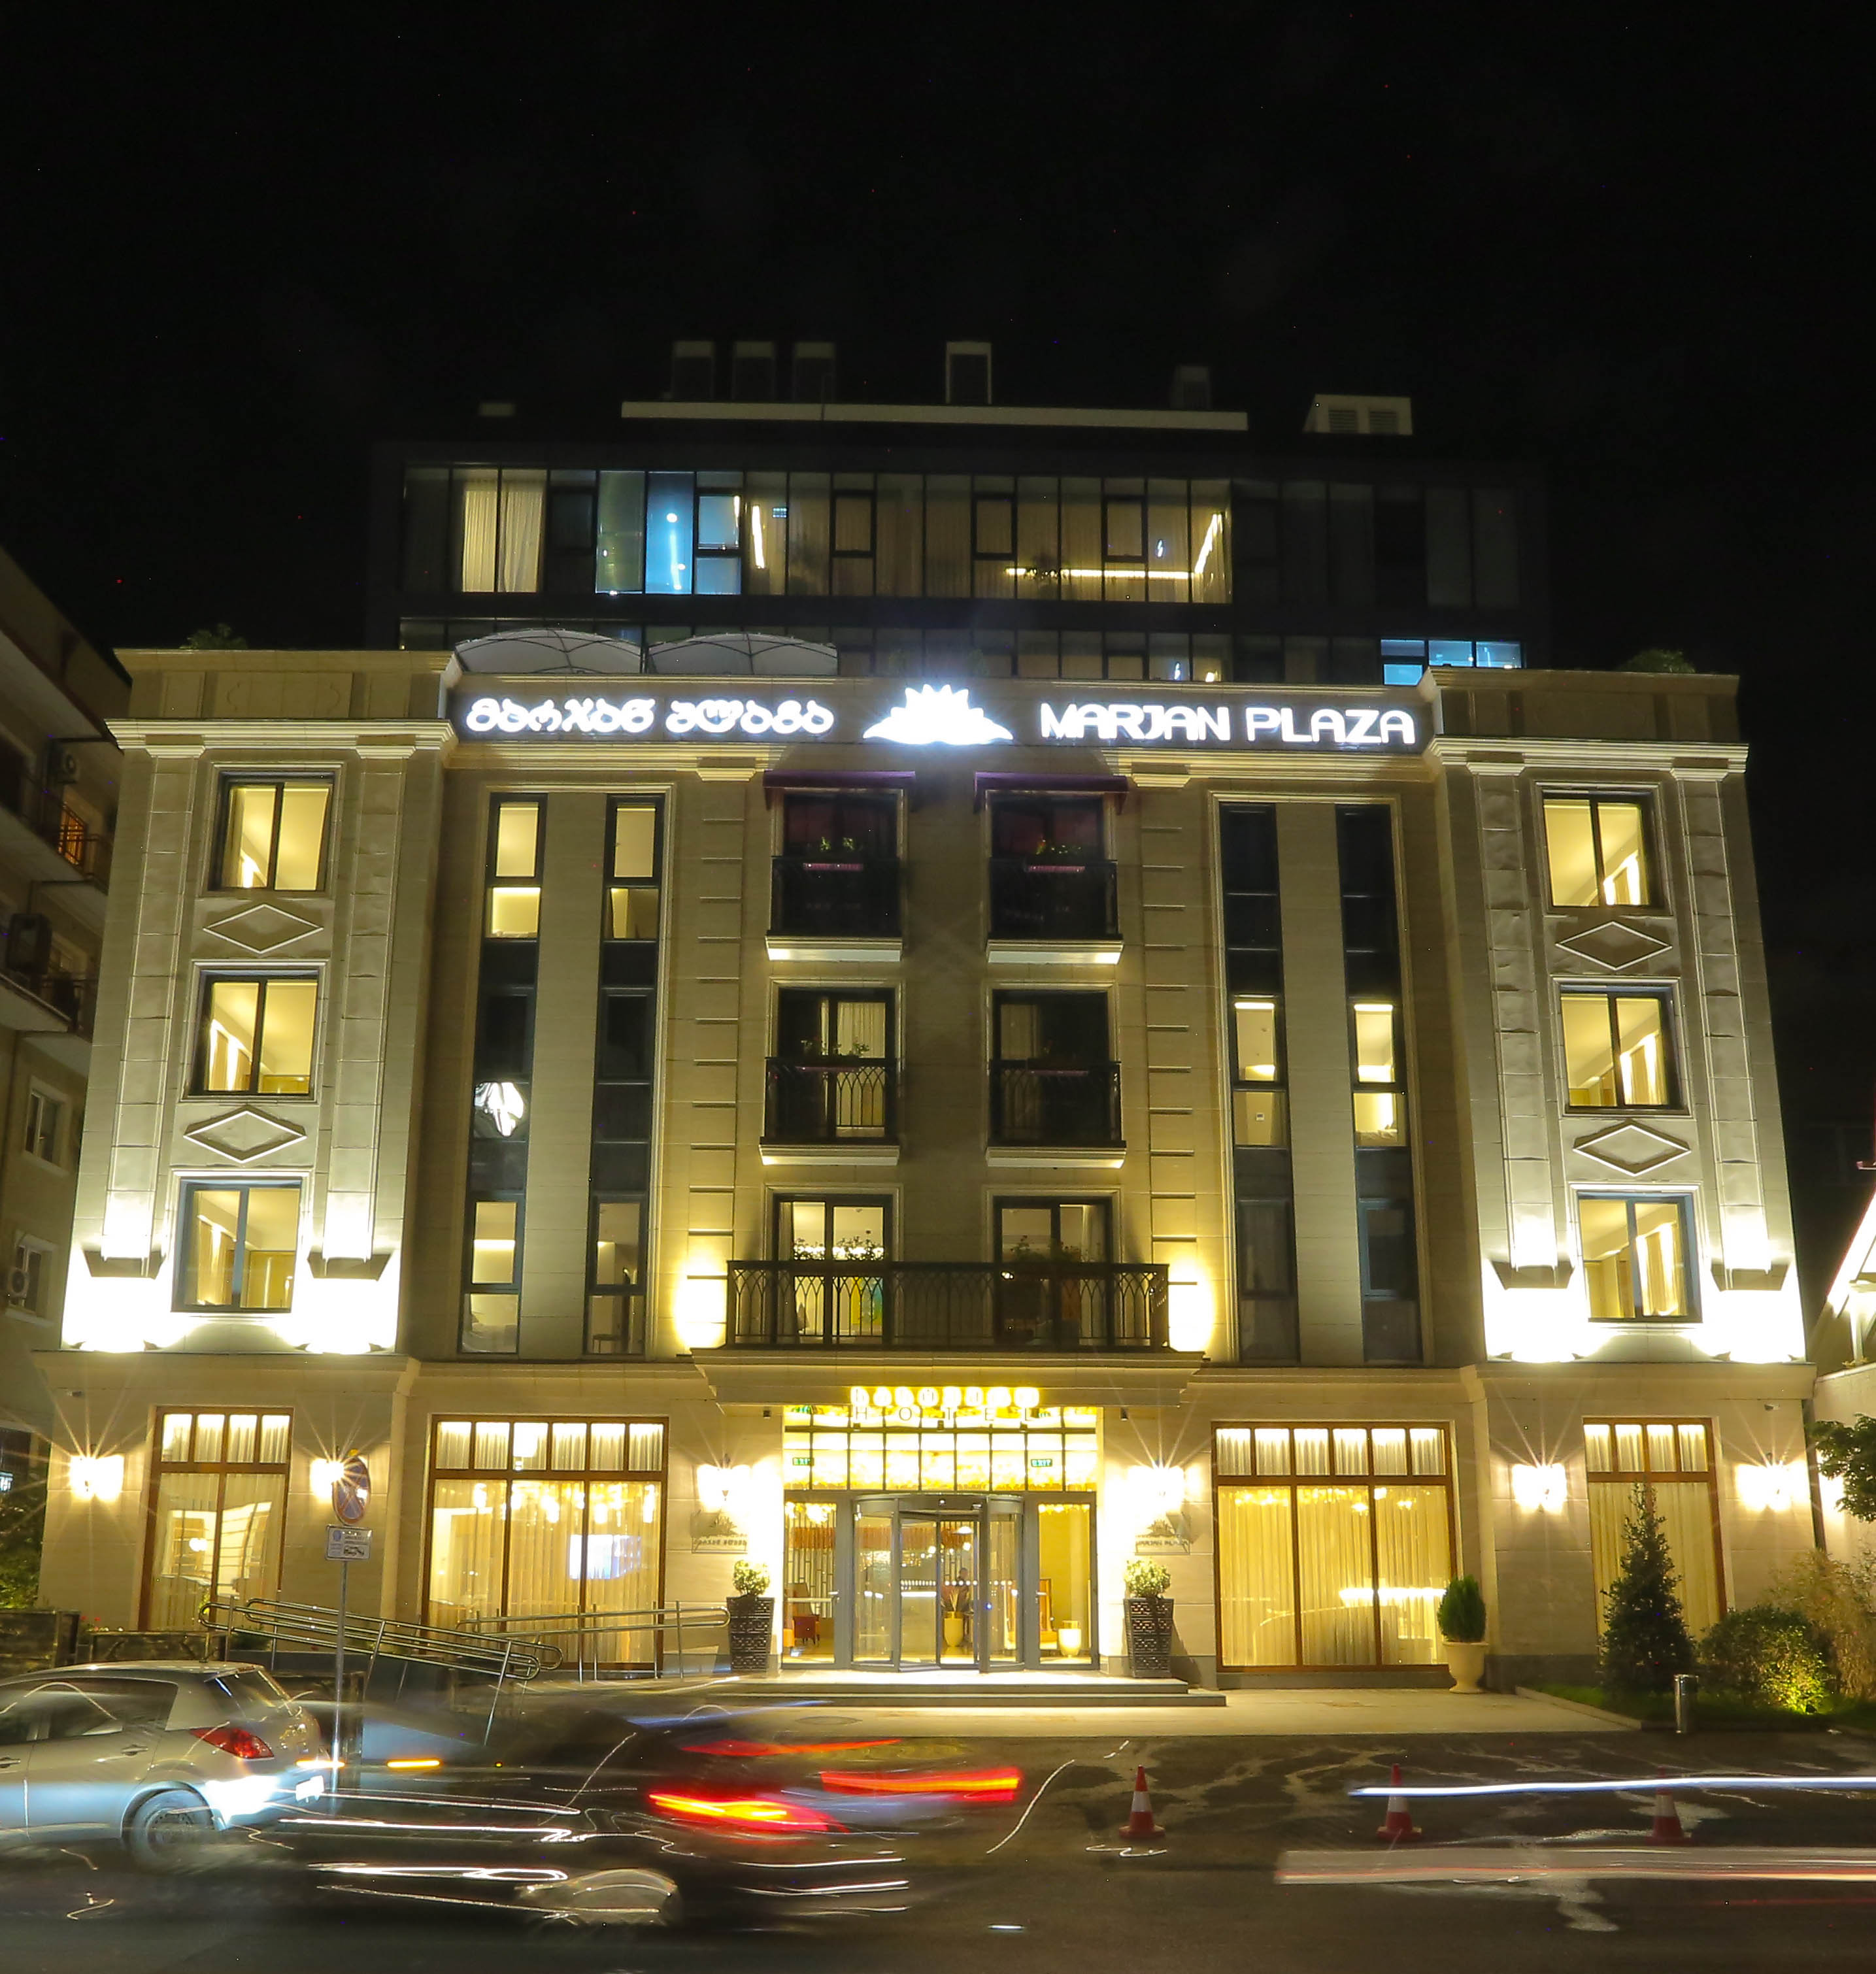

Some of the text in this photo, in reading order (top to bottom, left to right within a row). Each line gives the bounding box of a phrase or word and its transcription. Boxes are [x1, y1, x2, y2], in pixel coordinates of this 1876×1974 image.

[466, 698, 834, 734] მარჯან პლაზა
[1041, 703, 1415, 744] MARJAN PLAZA
[855, 1406, 1031, 1422] HOTEL
